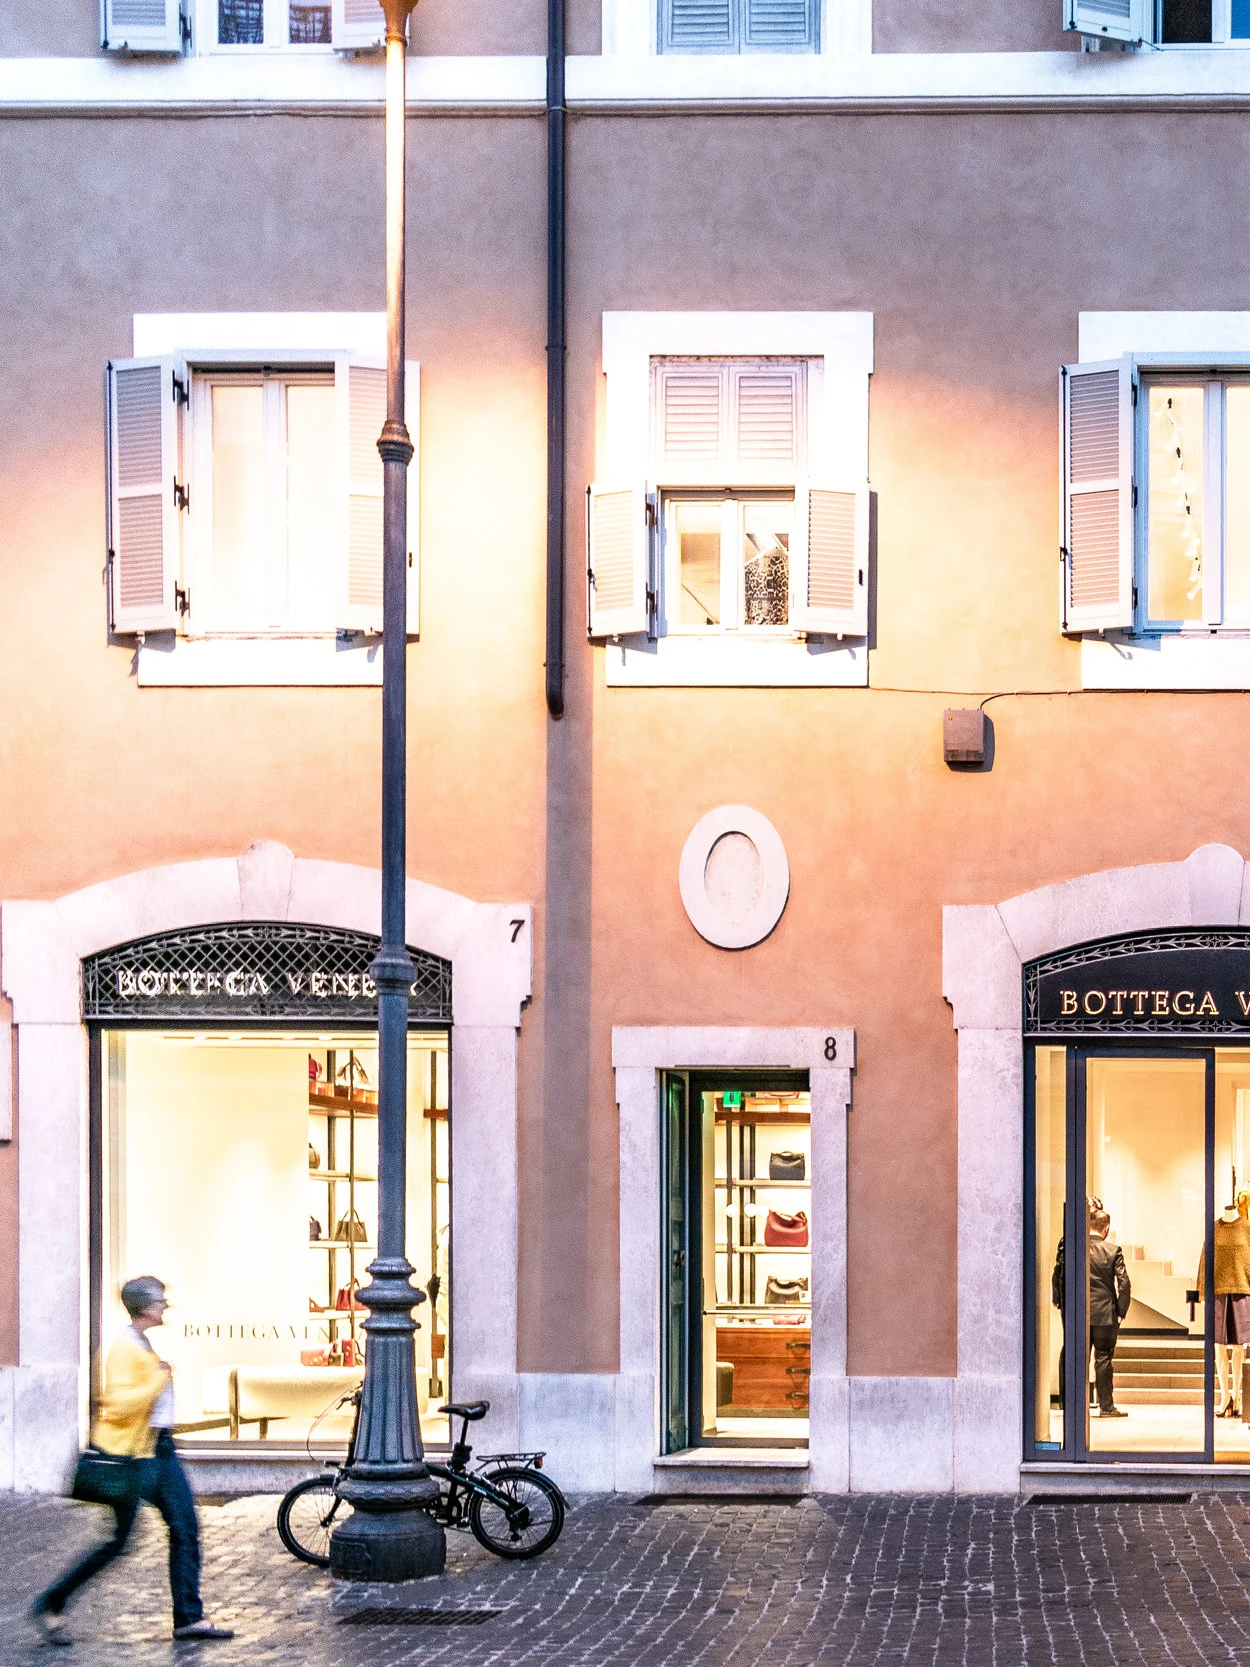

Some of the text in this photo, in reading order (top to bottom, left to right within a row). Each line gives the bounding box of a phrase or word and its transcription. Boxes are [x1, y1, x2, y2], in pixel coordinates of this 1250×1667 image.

[509, 919, 525, 943] 7
[1060, 990, 1219, 1016] BOTTEGA
[823, 1036, 837, 1062] 8
